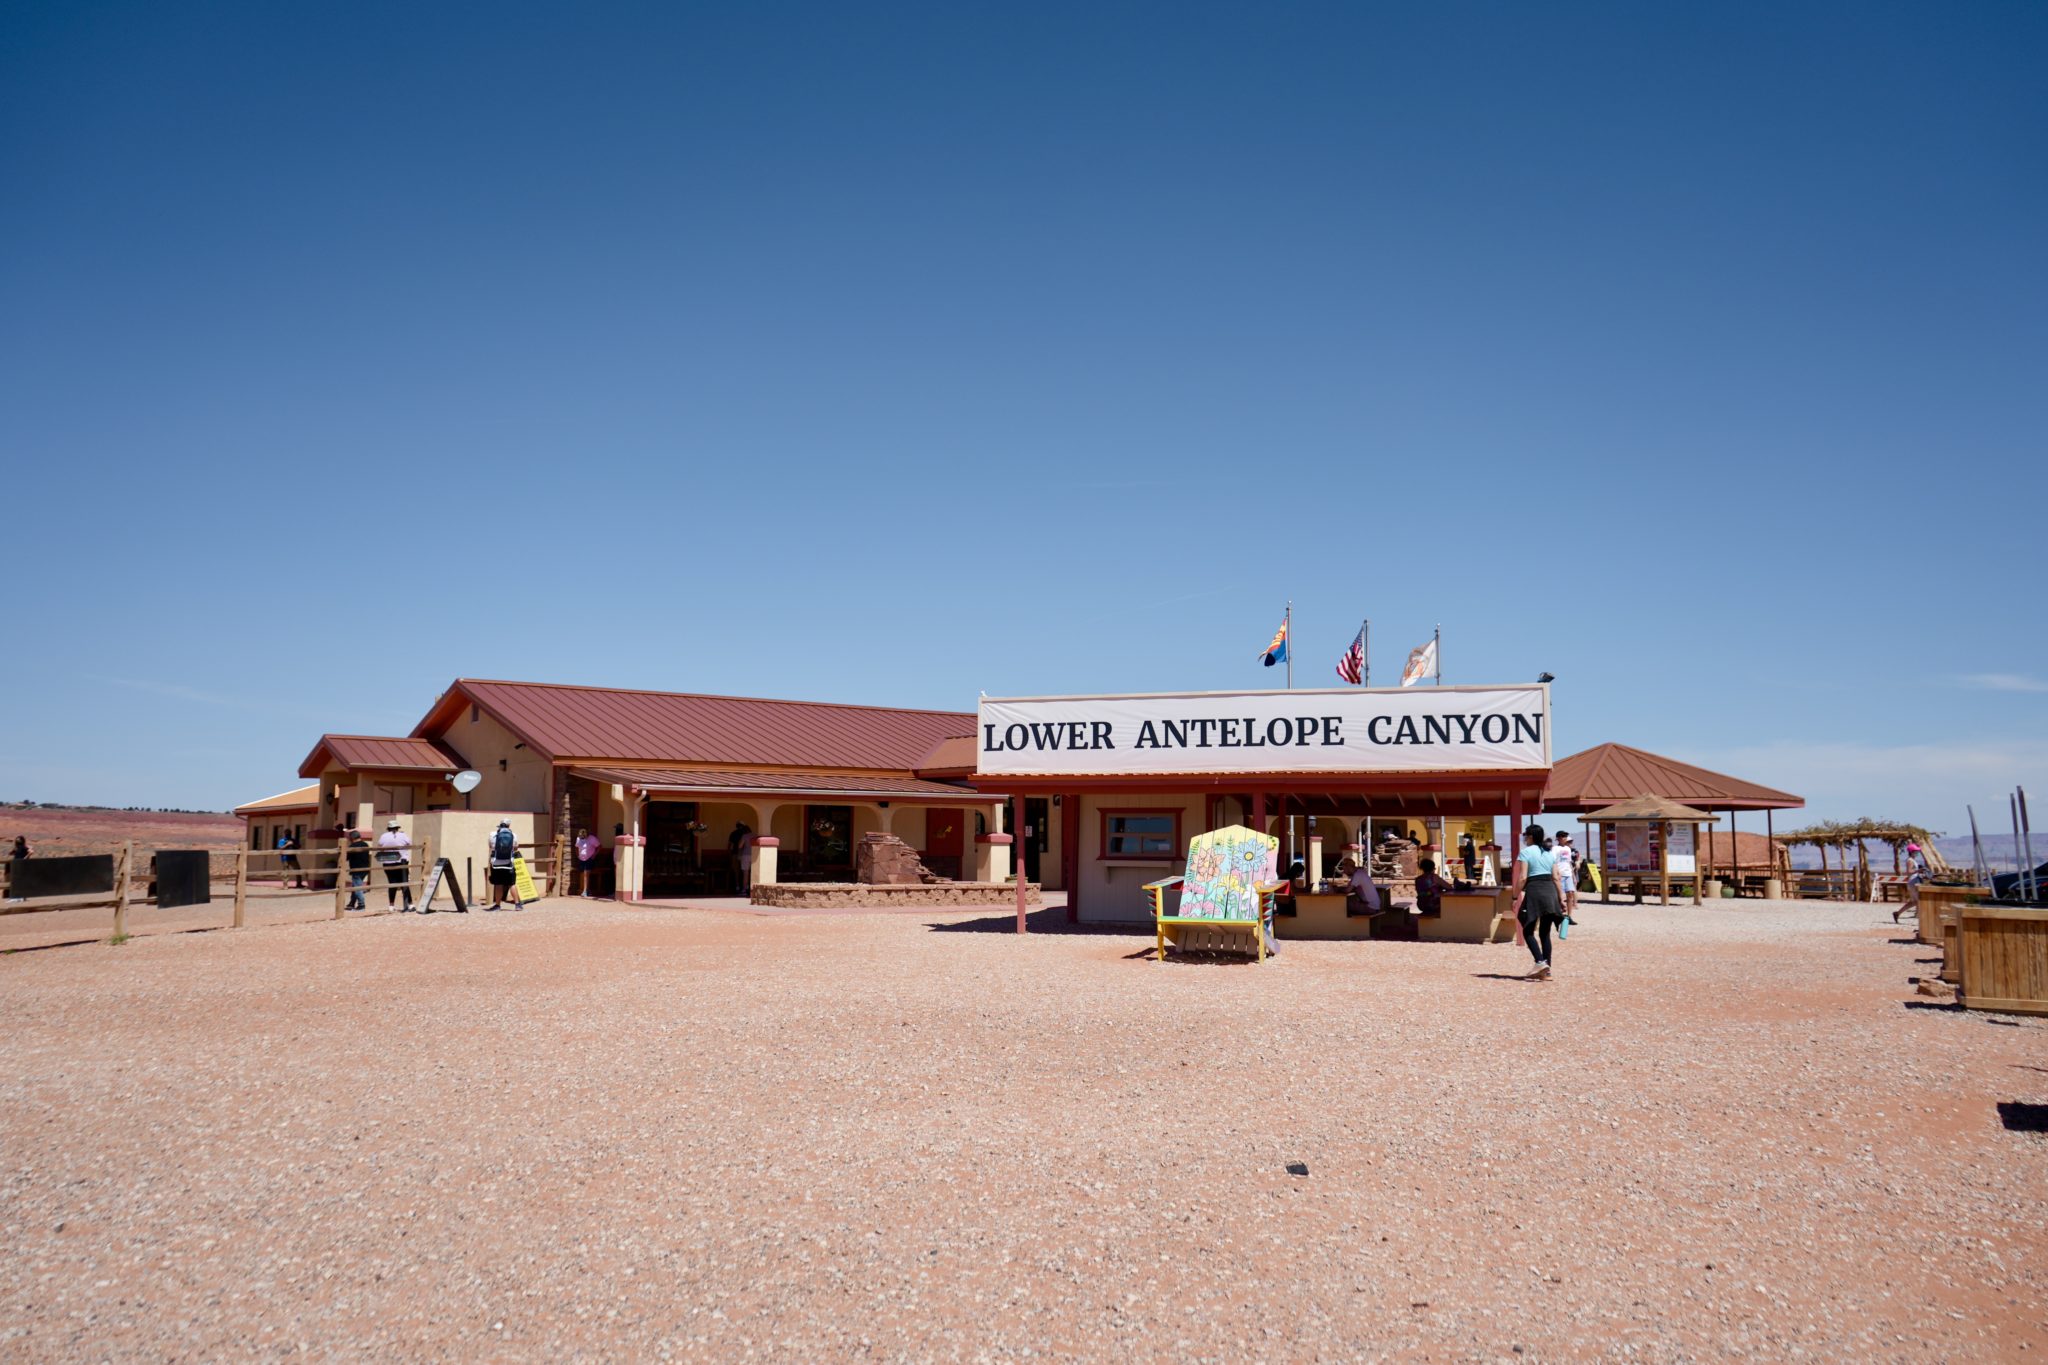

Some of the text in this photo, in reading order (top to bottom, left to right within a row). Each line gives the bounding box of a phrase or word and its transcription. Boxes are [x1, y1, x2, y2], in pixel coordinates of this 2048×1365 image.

[983, 713, 1543, 751] LOWER ANTELOPE CANYON
